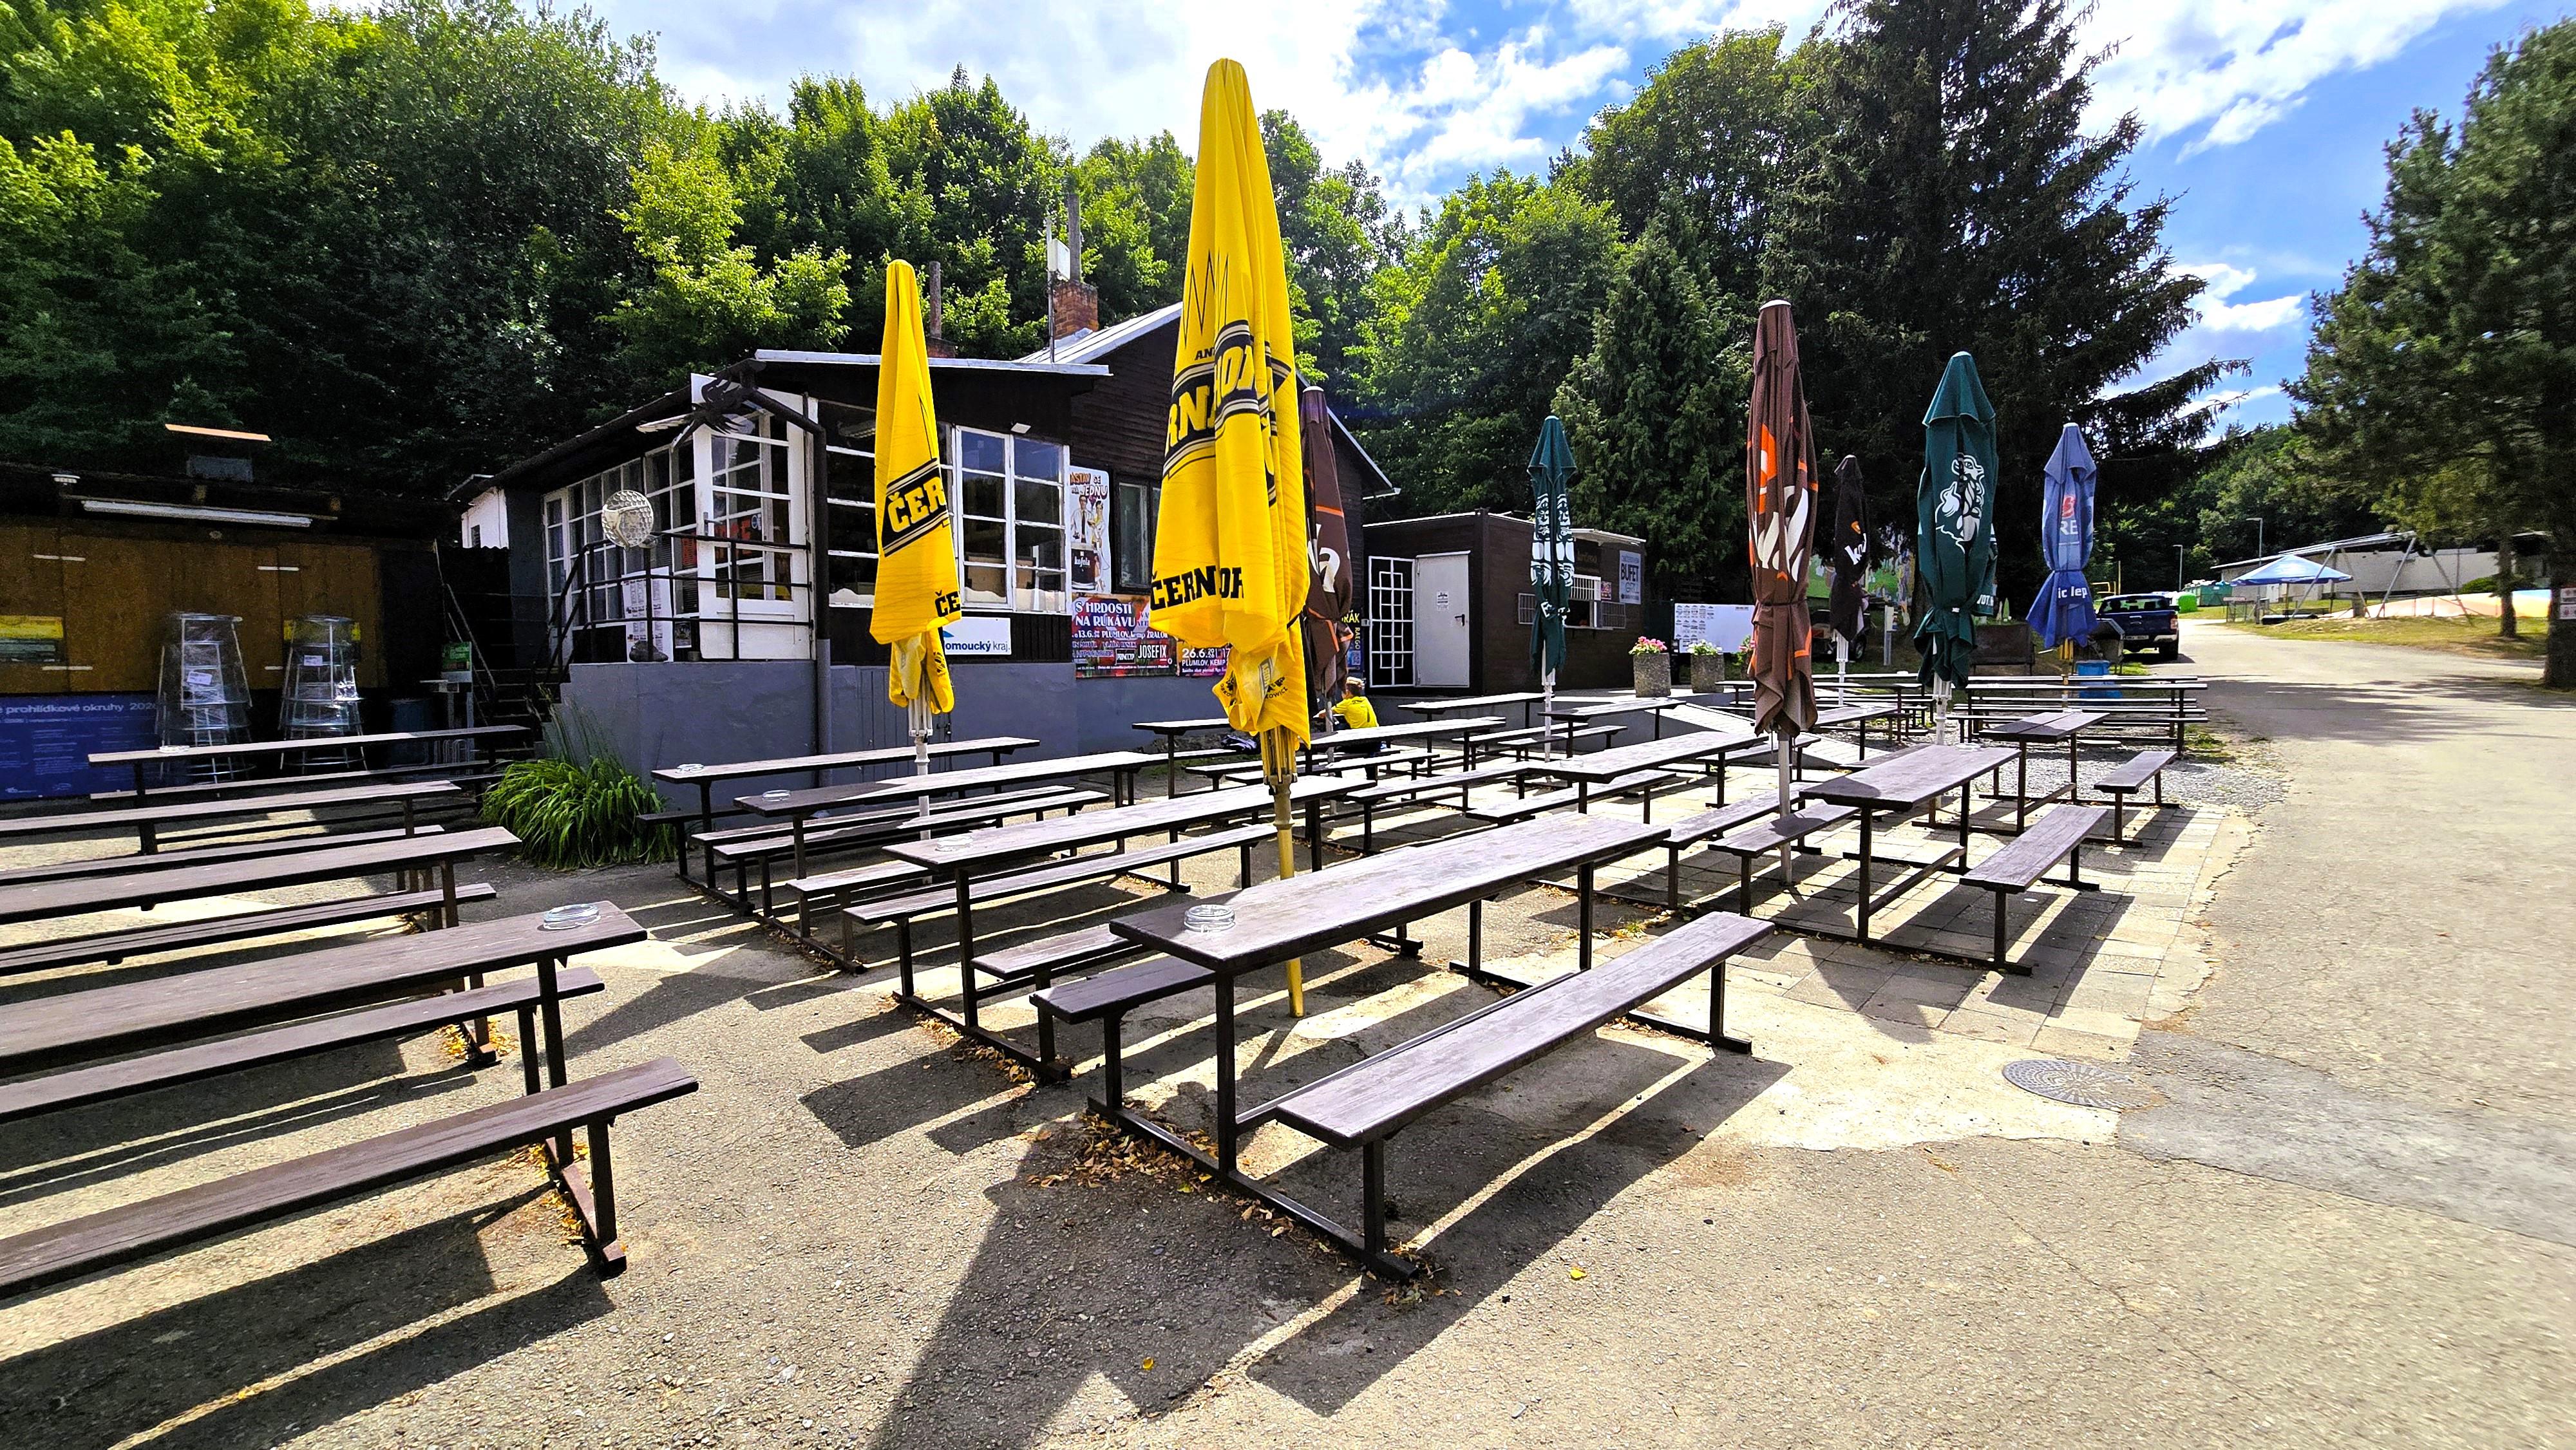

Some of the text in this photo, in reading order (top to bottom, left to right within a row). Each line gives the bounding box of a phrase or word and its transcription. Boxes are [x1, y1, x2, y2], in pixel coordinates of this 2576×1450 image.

[1070, 472, 1091, 485] ASTAV
[1080, 484, 1108, 500] JEDNU
[887, 476, 947, 533] ČER
[1621, 563, 1639, 582] BUFET
[1150, 565, 1217, 611] ČERN
[2058, 585, 2088, 599] ic lep
[934, 590, 961, 618] ČE
[1075, 601, 1132, 614] S HRDOSTÍ
[1075, 616, 1090, 626] NA
[1094, 614, 1135, 627] RUKÁVU
[945, 641, 991, 652] omoucký
[1138, 645, 1167, 659] JOSEFIX
[82, 702, 124, 712] okruhy
